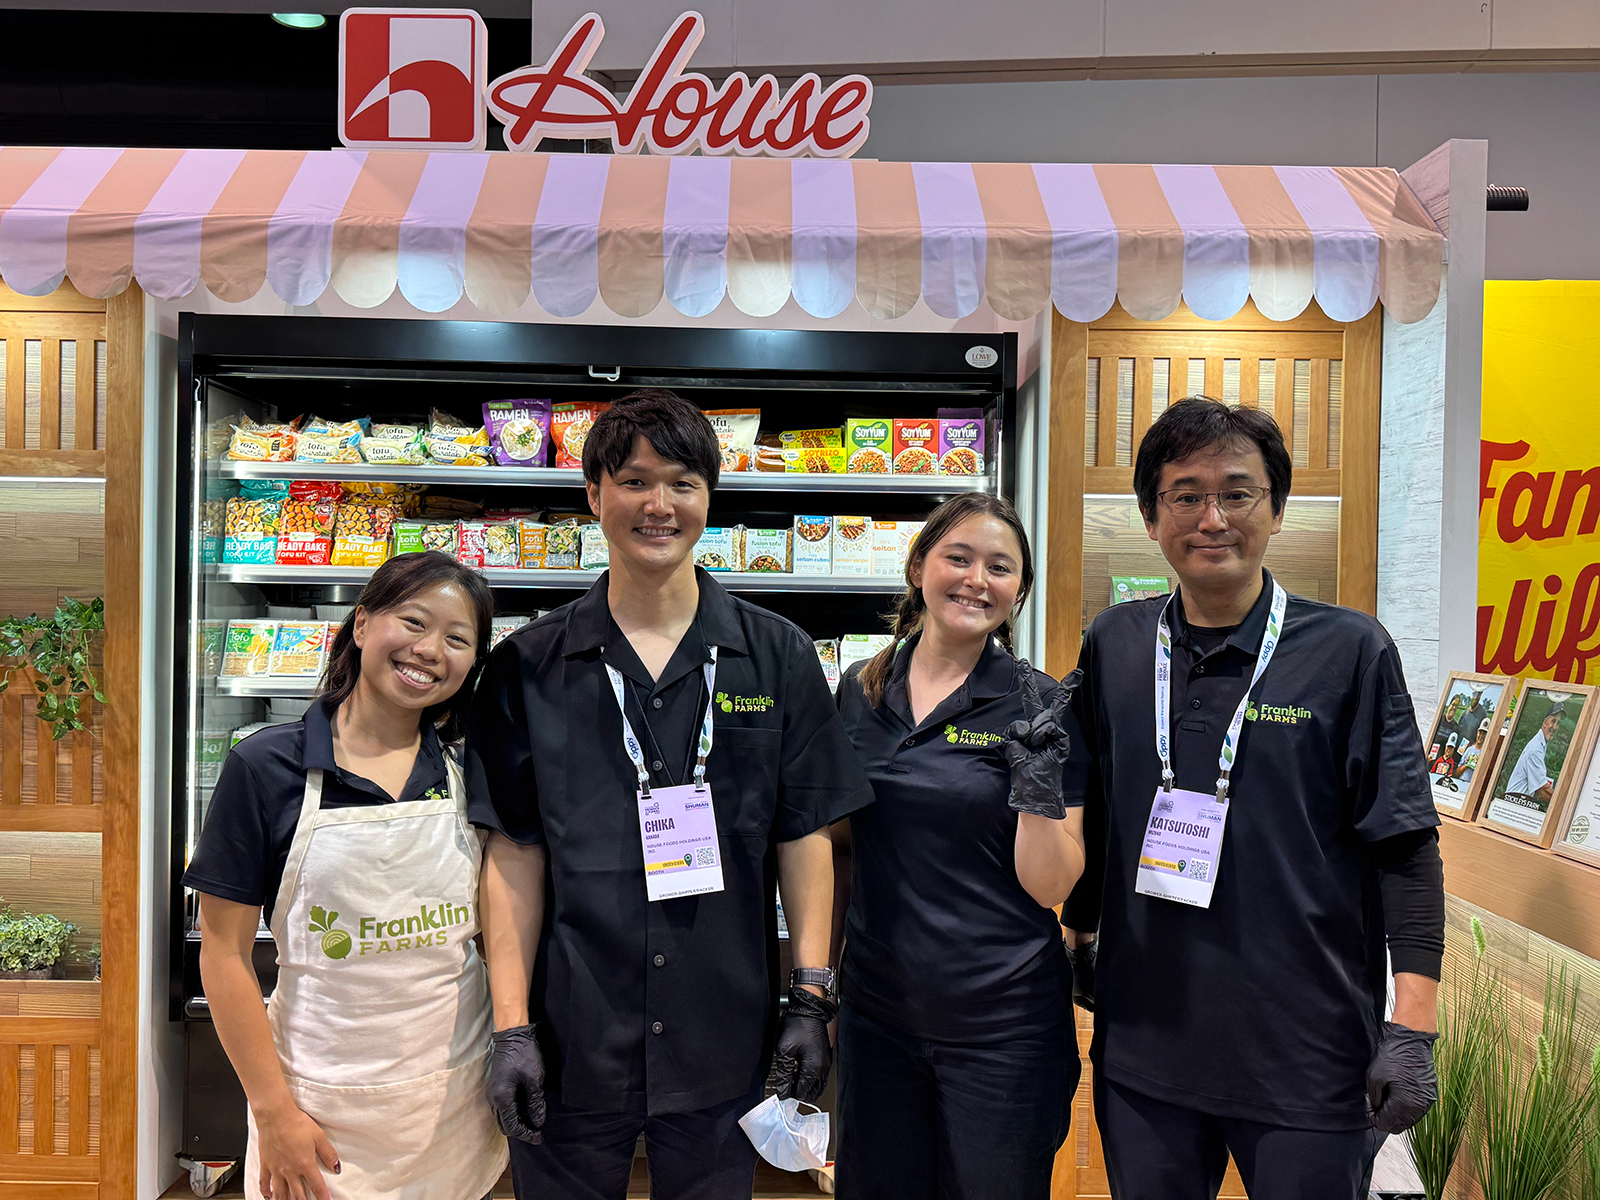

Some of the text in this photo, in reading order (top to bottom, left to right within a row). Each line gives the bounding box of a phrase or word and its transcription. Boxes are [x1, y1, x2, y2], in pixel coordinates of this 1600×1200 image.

[490, 16, 868, 149] House
[490, 409, 529, 421] RAMEN
[553, 409, 591, 423] RAMEN
[709, 417, 728, 427] ofu
[800, 429, 835, 438] SOYRIZO
[804, 449, 839, 457] SOYRIZO
[524, 536, 543, 544] tofu
[277, 541, 327, 551] READY BAKE
[362, 544, 384, 553] BAKE
[231, 633, 249, 642] Tofu
[280, 633, 300, 642] Tofu
[734, 694, 775, 708] Franklin
[734, 704, 767, 713] FARMS
[1261, 702, 1313, 719] Franklin
[1260, 713, 1298, 724] FARMS
[961, 729, 1002, 743] Franklin
[959, 738, 988, 747] FARMS
[685, 802, 709, 810] SHUMAN
[645, 817, 675, 833] CHIKA
[1150, 816, 1210, 839] KATSUTOSHI
[1178, 845, 1200, 853] HOLDINGS
[358, 902, 470, 940] Franklin
[358, 929, 448, 956] FARMS
